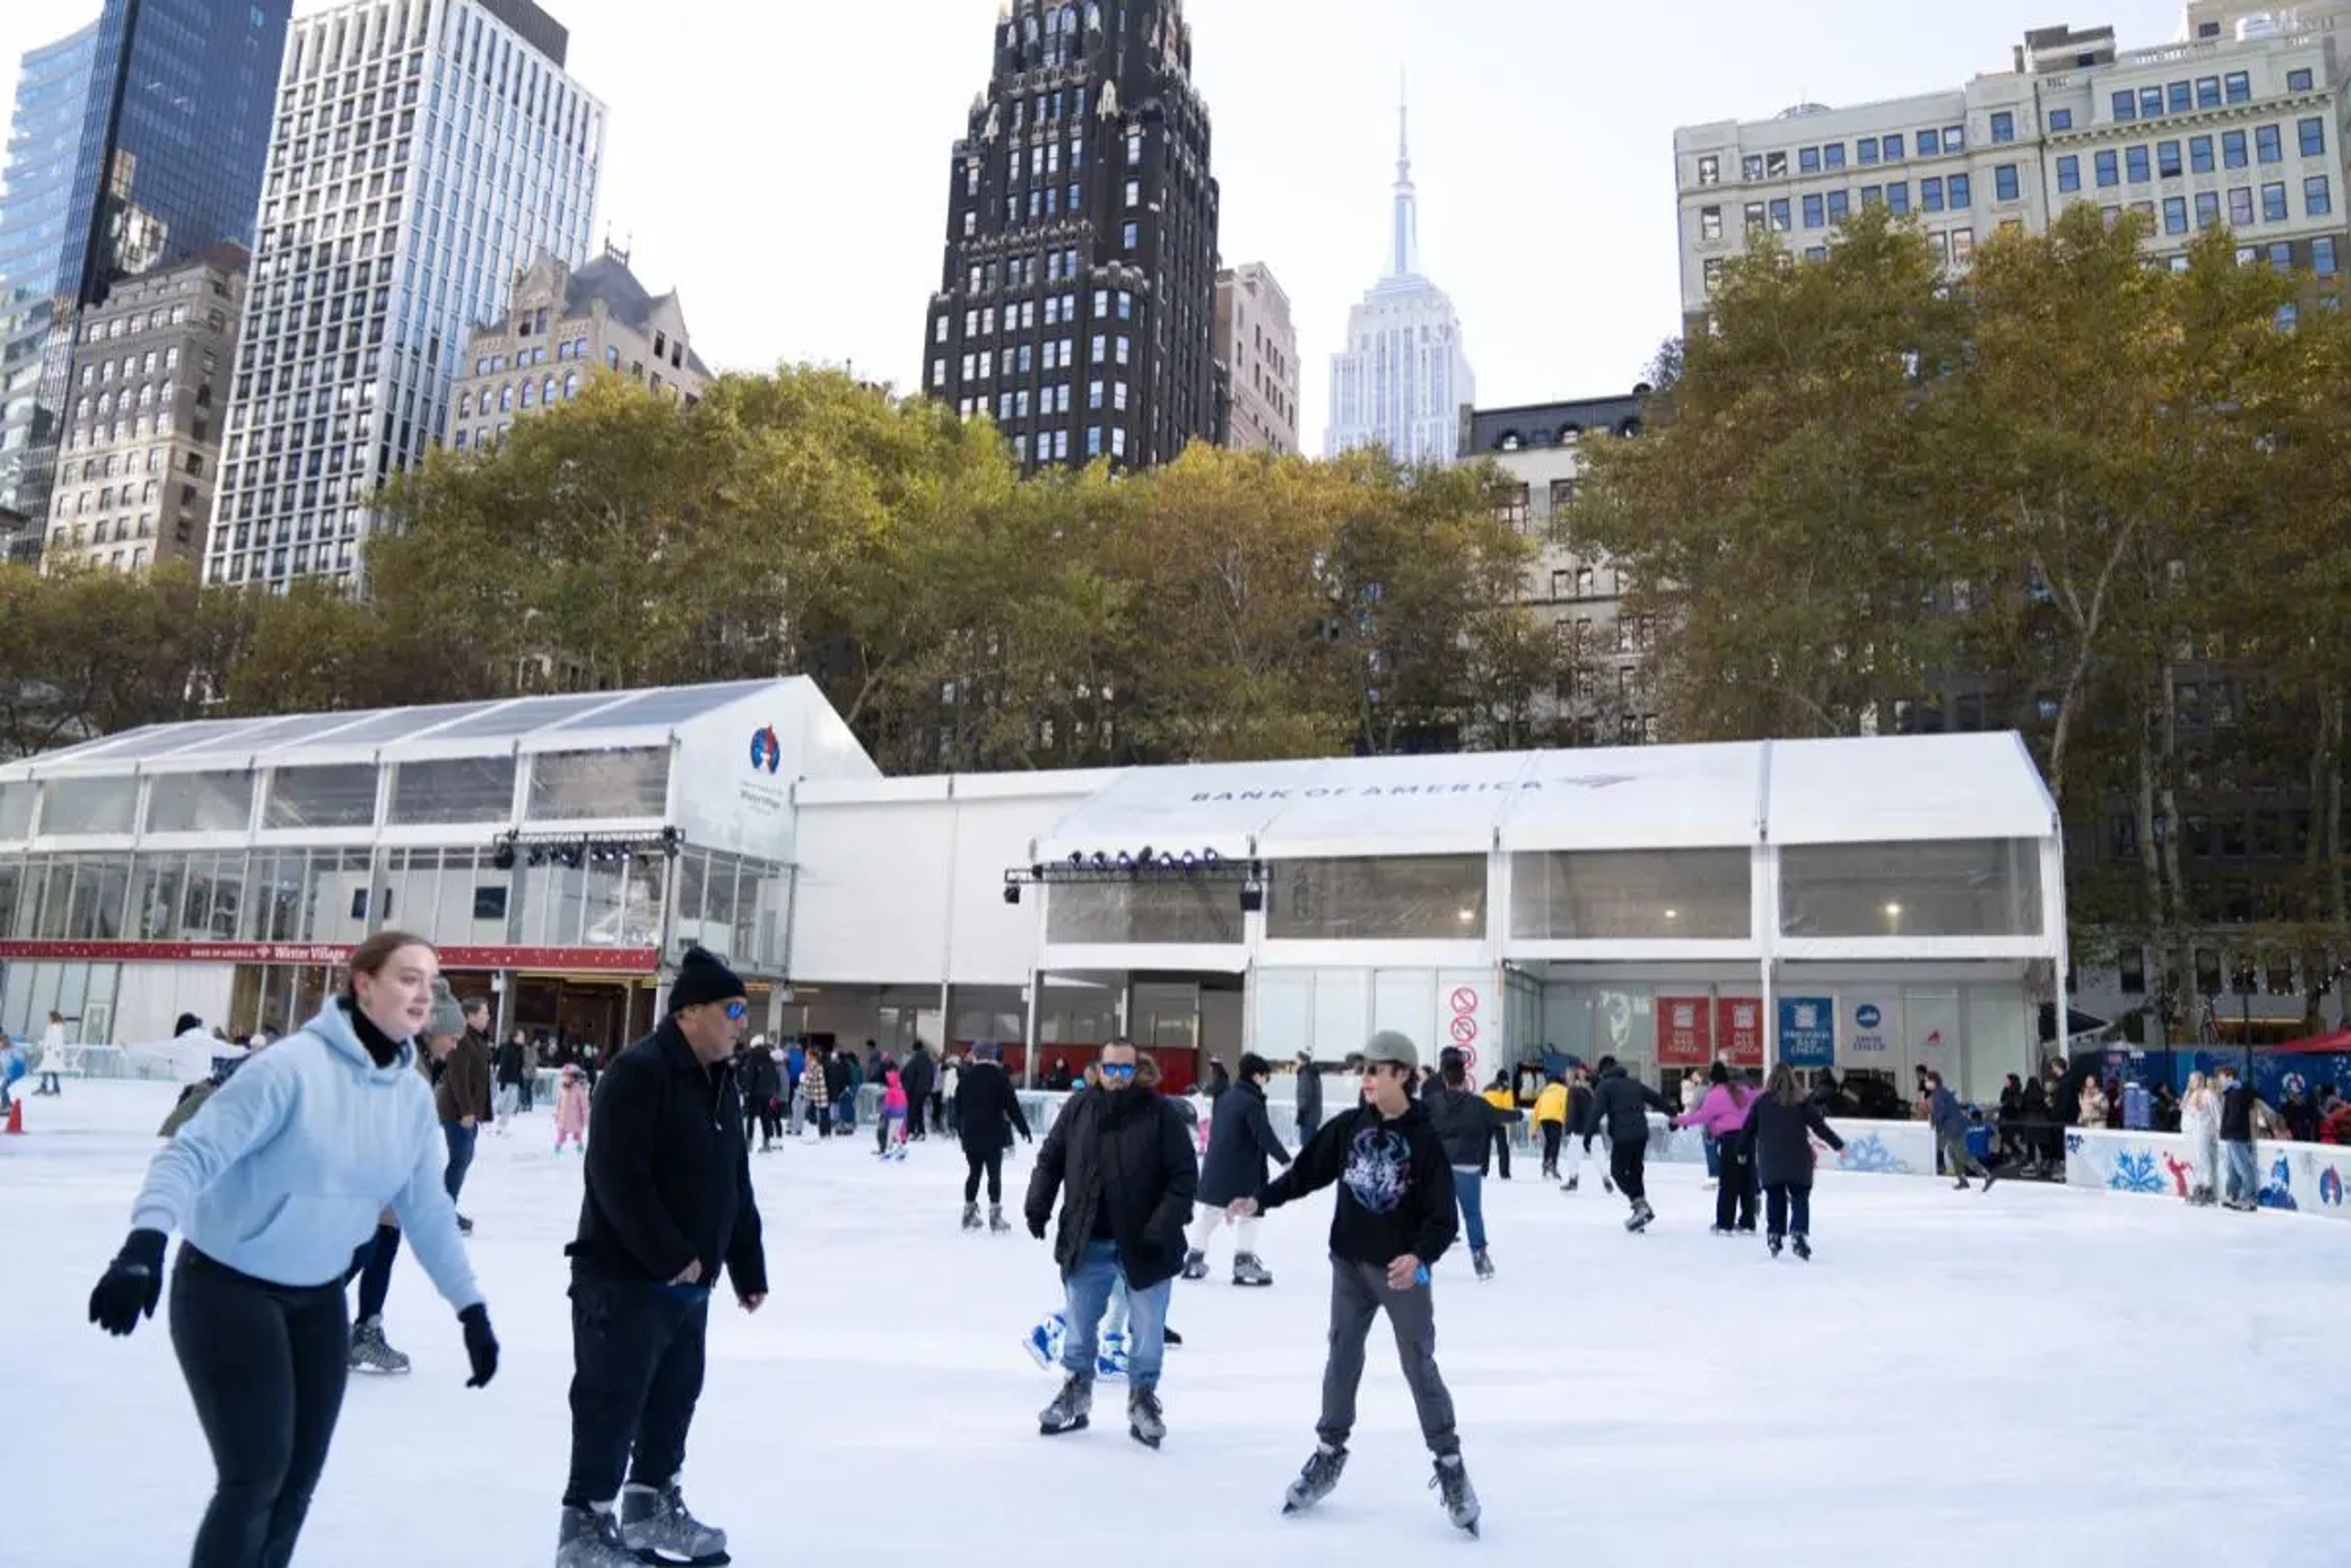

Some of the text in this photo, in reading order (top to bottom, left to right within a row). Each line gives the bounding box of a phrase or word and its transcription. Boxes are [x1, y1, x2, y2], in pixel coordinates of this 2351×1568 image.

[1191, 780, 1542, 802] BANK OF AMERICA
[275, 947, 309, 959] Winter
[311, 947, 347, 965] Village
